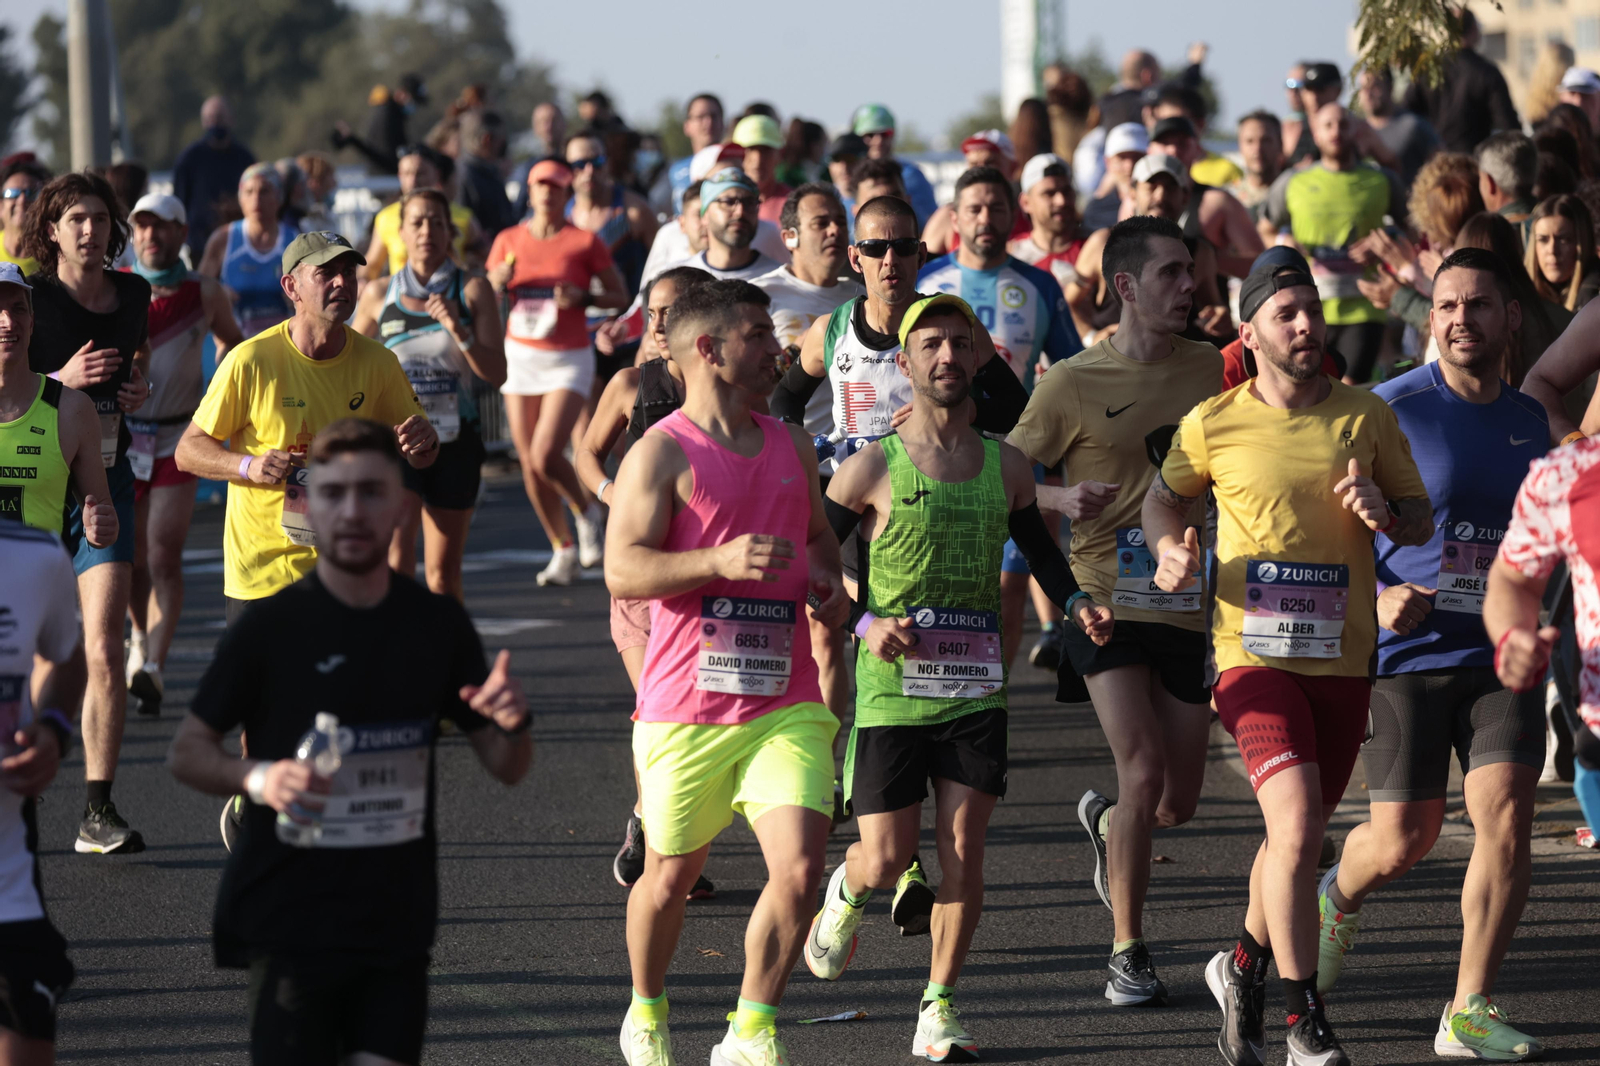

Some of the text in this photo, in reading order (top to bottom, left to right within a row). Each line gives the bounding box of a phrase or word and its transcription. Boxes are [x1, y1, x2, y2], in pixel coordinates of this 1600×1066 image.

[1281, 567, 1338, 582] ZURICH
[1451, 577, 1480, 591] JOSÉ
[736, 603, 789, 618] ZURICH
[1280, 597, 1316, 613] 6250
[938, 613, 987, 628] ZURICH
[1277, 622, 1315, 634] ALBER
[735, 633, 769, 649] 6853
[938, 641, 970, 656] 6407
[708, 655, 786, 672] DAVID ROMERO
[917, 664, 989, 677] NOE ROMERO
[357, 727, 423, 748] ZURICH
[1256, 751, 1299, 777] LURBEL
